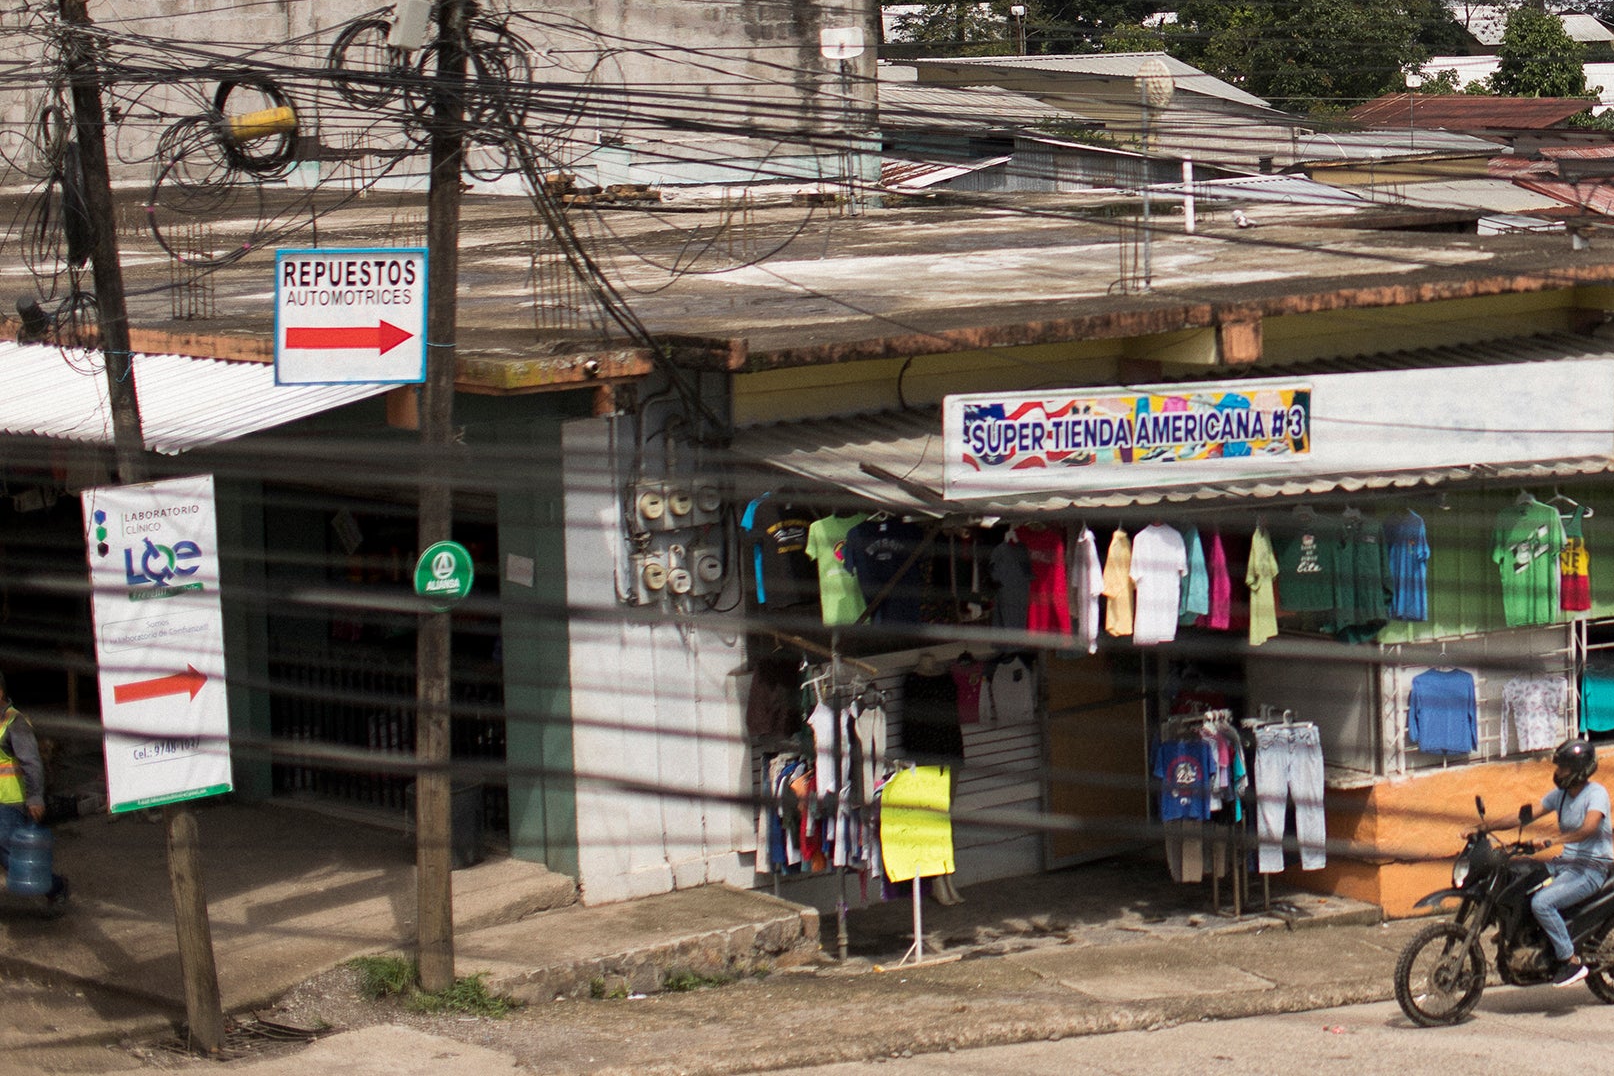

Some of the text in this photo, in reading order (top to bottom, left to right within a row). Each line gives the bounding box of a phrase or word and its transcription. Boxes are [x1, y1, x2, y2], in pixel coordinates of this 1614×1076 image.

[283, 260, 416, 287] REPUESTOS
[286, 289, 412, 306] AUTOMOTRICES
[972, 421, 1046, 455] SUPER
[1052, 417, 1129, 450] TIENDA
[1136, 409, 1265, 445] AMERICANA
[125, 505, 199, 522] LABORATORIO
